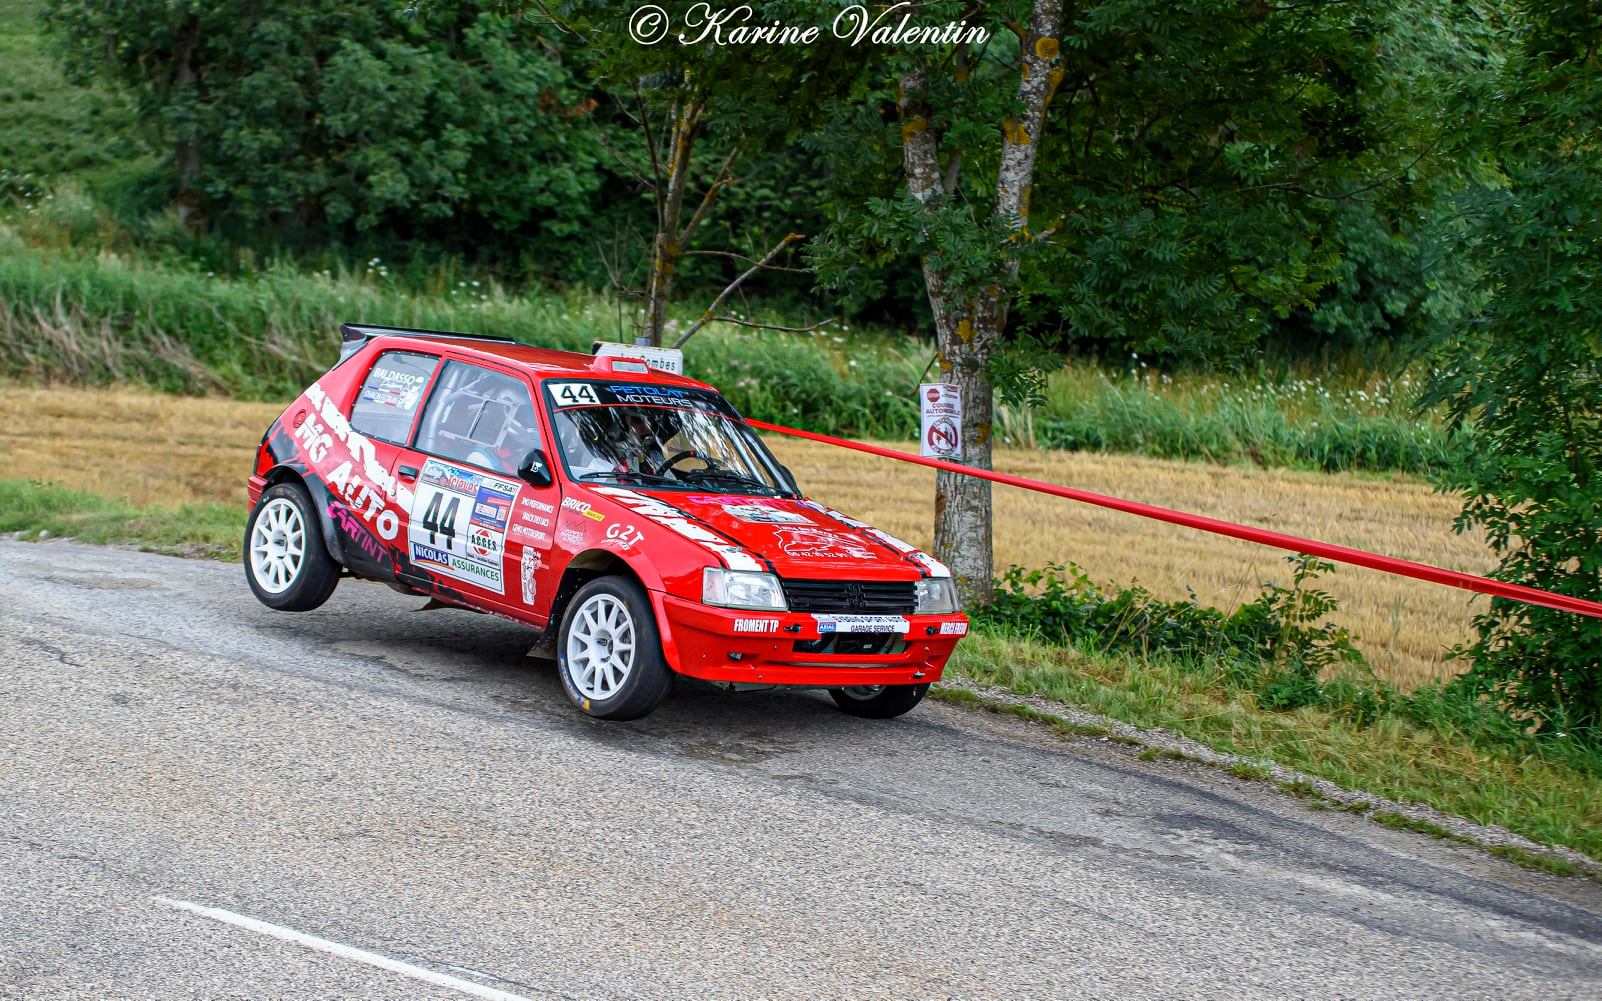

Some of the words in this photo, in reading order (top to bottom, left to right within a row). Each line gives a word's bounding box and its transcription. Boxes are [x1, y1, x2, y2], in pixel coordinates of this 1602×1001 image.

[373, 367, 416, 385] BALDASSO
[561, 385, 595, 404] 44
[610, 385, 684, 398] PETOLAT
[616, 395, 692, 407] MOTEURS
[295, 413, 333, 463] MG
[327, 461, 399, 541] AUTO
[494, 482, 514, 494] FFSA
[561, 496, 592, 512] BRICO
[423, 491, 461, 551] 44
[606, 523, 645, 547] G2T
[415, 544, 448, 565] NICOLAS
[451, 558, 499, 582] ASSURANCES
[734, 618, 769, 632] FROMENT
[769, 619, 779, 633] TP
[850, 624, 873, 633] GARAGE
[873, 624, 896, 633] SERVICE
